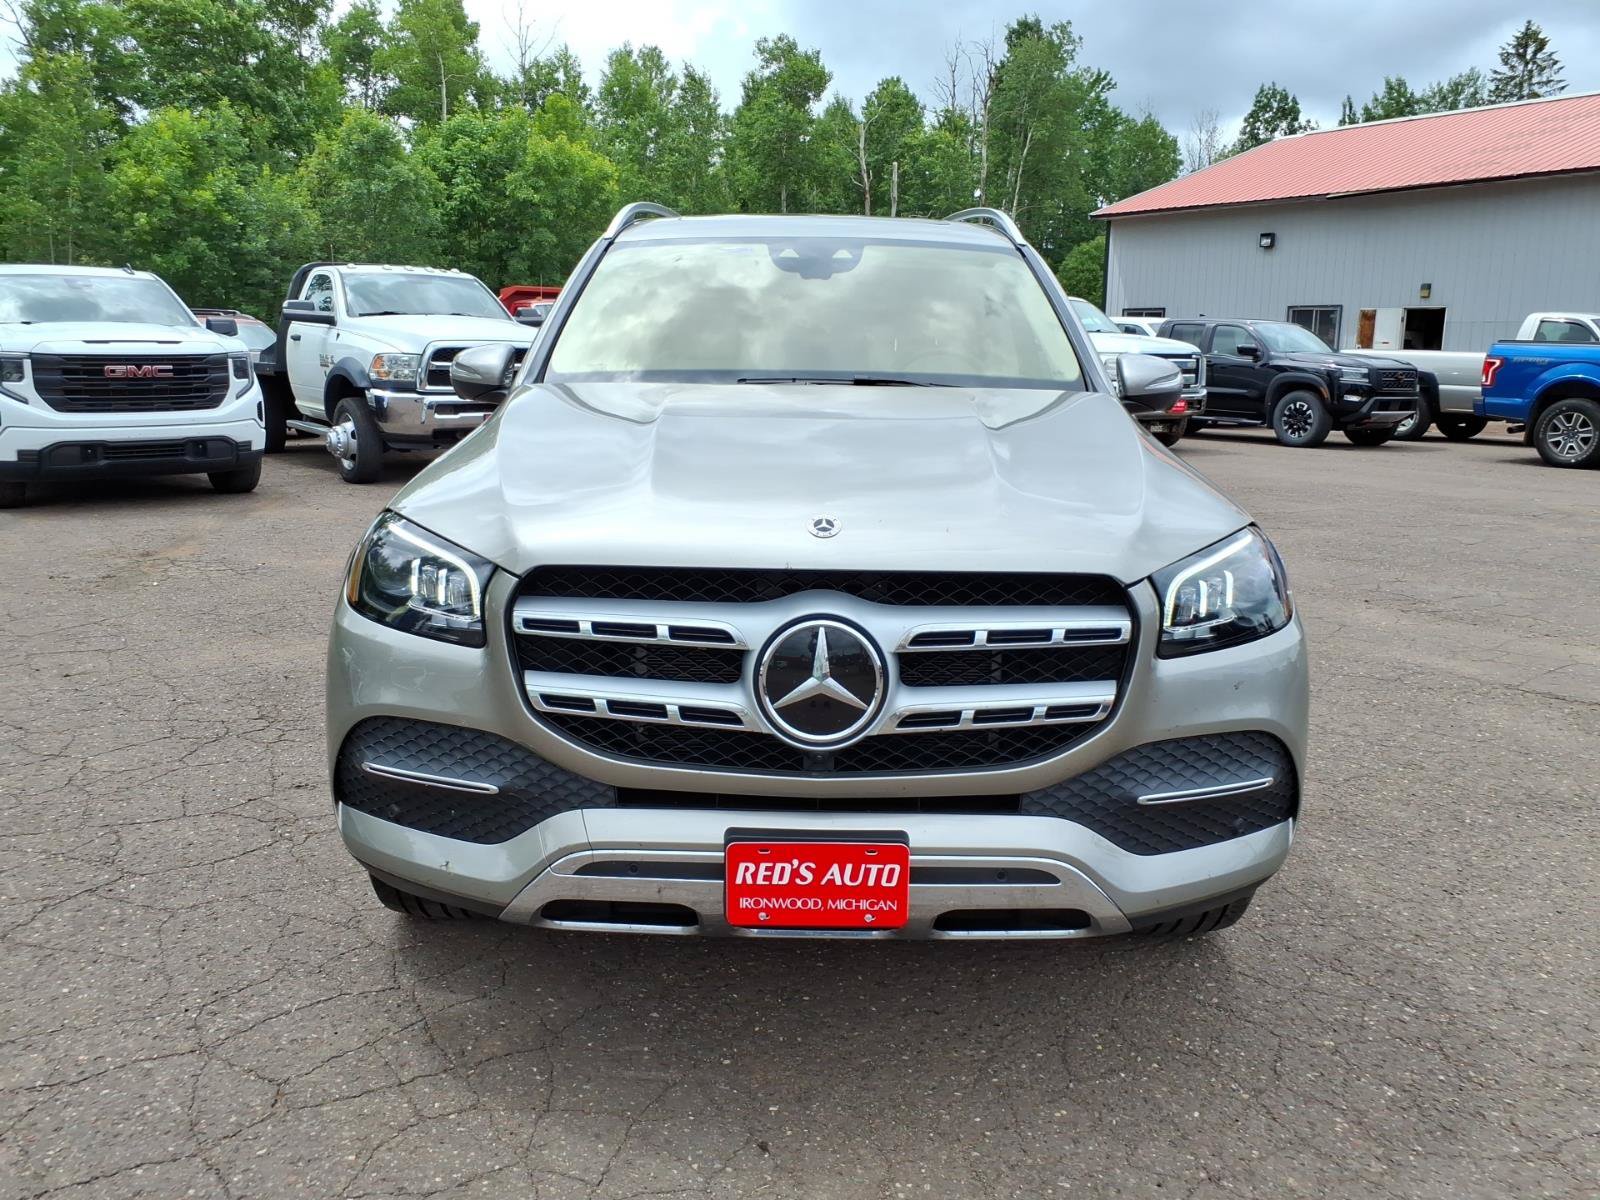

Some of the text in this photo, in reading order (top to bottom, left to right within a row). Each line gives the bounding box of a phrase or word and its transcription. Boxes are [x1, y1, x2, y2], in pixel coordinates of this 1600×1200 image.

[104, 365, 174, 378] GMC
[735, 858, 901, 887] RED'S AUTO
[739, 897, 898, 912] IRONWOOD, MICHIGAN
